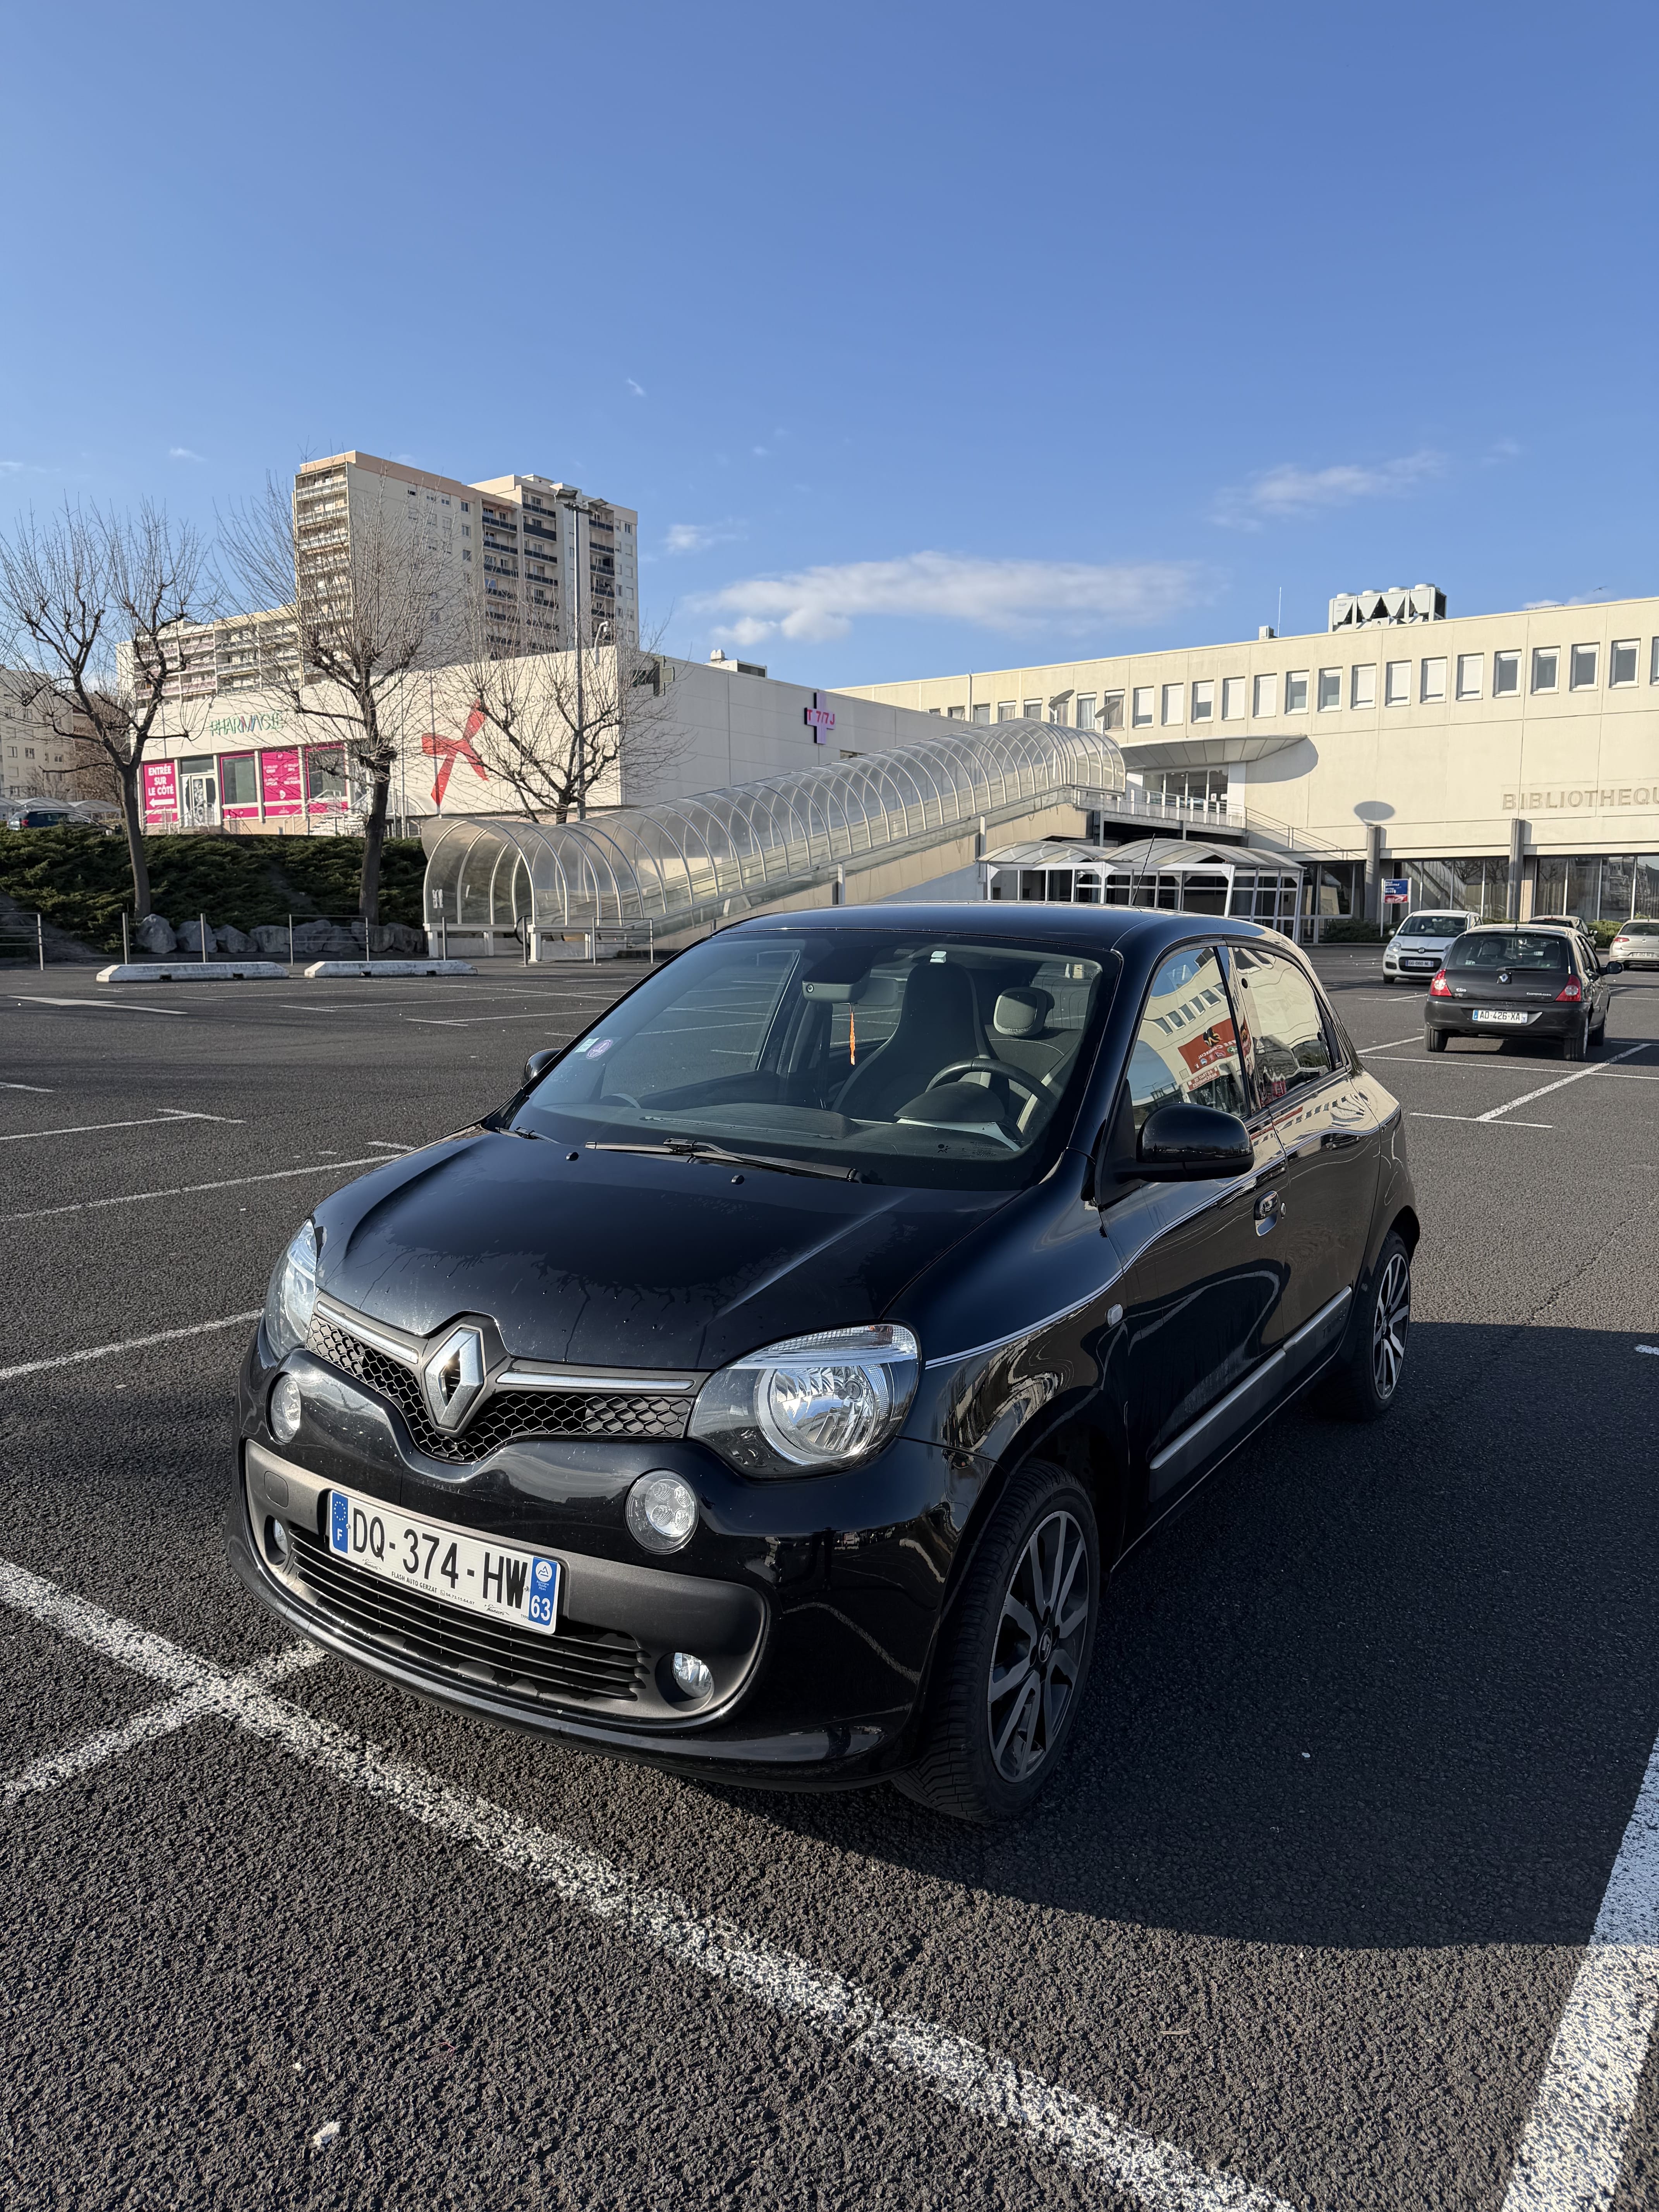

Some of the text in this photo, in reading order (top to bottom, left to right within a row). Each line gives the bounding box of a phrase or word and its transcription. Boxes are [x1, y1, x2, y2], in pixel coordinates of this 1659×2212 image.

[211, 713, 284, 737] PHARMACIE
[148, 764, 172, 776] ENTRÉE
[154, 776, 167, 786] SUR
[148, 784, 174, 796] LE CÔTÉ
[337, 1528, 343, 1540] F
[392, 1571, 405, 1581] FLASH
[406, 1577, 418, 1586] AUTO
[419, 1582, 437, 1593] GERZAT
[531, 1595, 550, 1621] 63
